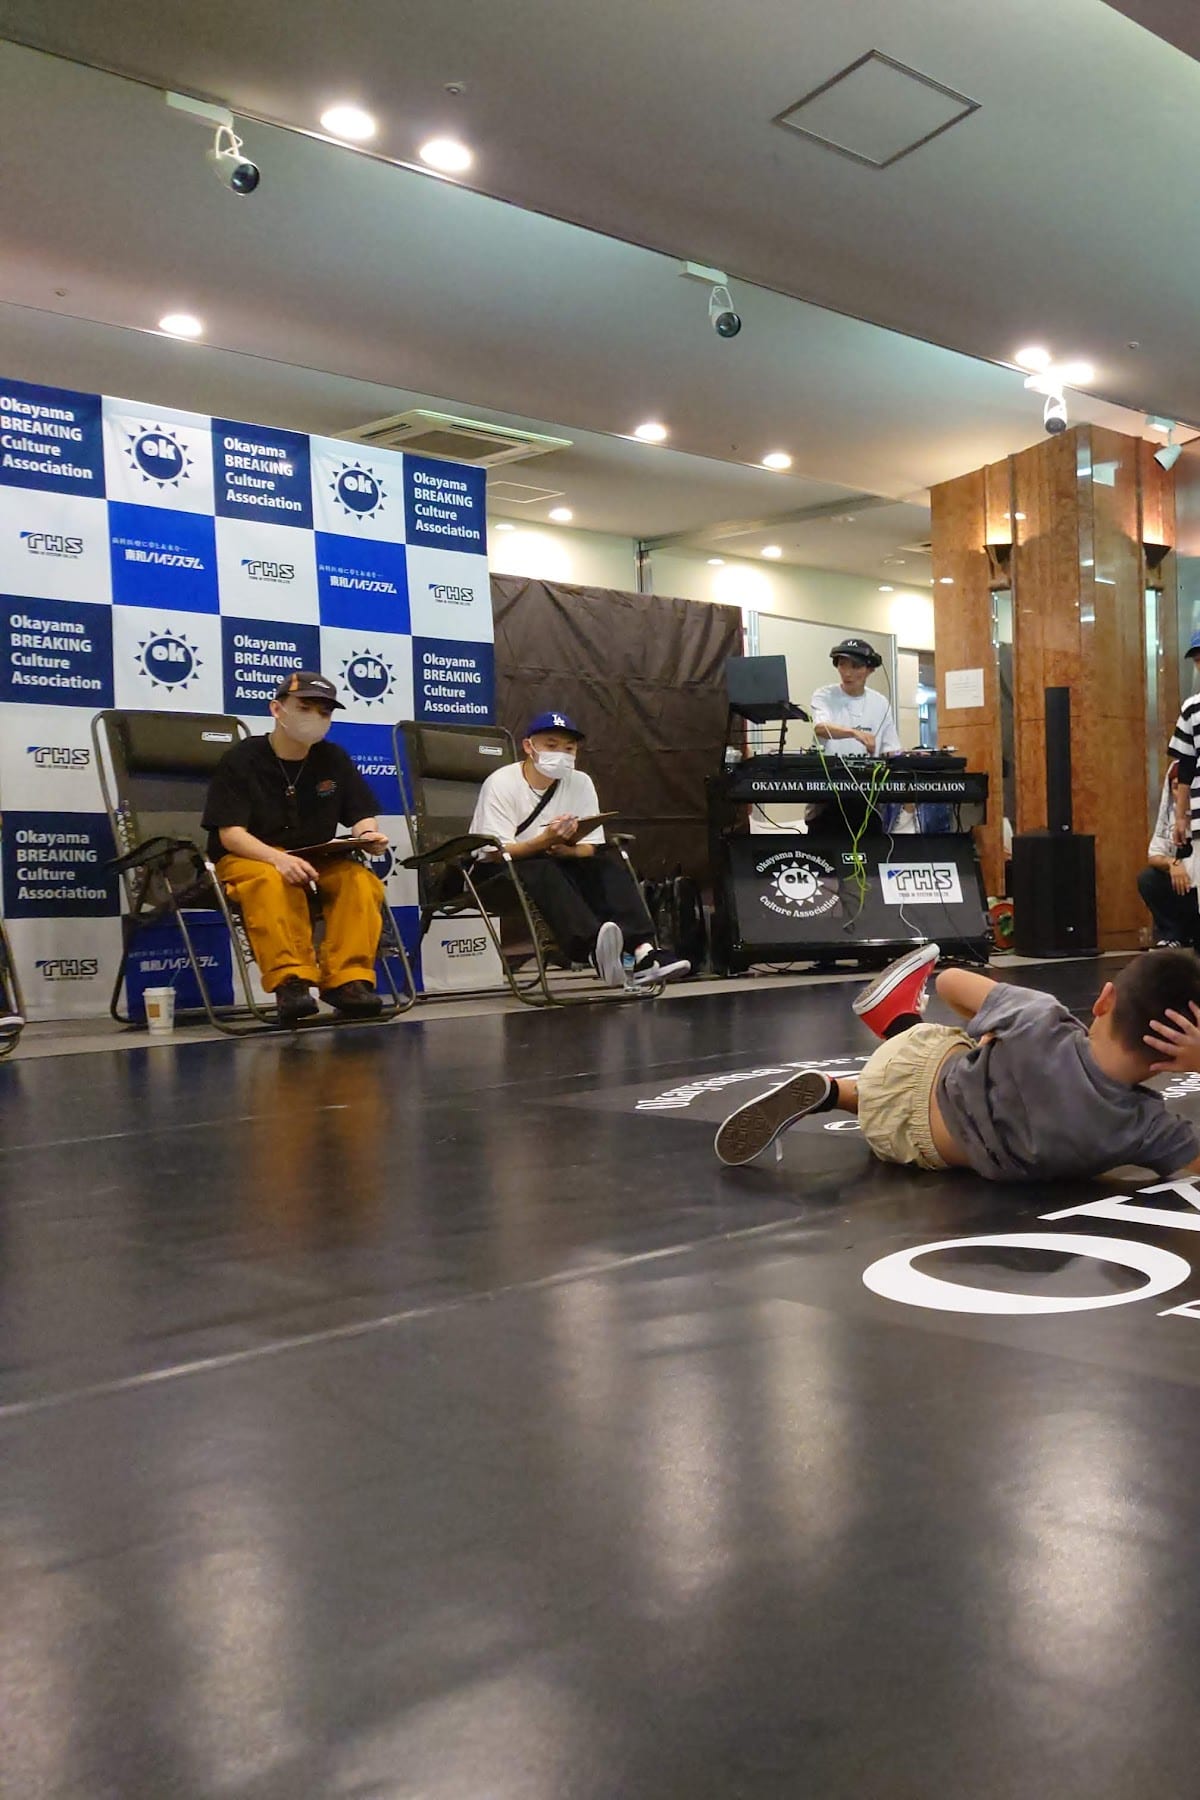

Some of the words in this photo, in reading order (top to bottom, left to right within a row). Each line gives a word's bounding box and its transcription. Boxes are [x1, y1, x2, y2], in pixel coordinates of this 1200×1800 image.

[0, 397, 75, 422] Okayama
[0, 415, 83, 442] BREAKING
[1, 435, 61, 456] Culture
[224, 437, 287, 459] Okayama
[3, 454, 93, 479] Association
[225, 454, 294, 477] BREAKING
[225, 471, 276, 491] Culture
[413, 471, 468, 492] Okayama
[226, 489, 302, 511] Association
[414, 487, 473, 508] BREAKING
[414, 503, 458, 520] Culture
[415, 519, 480, 540] Association
[19, 531, 83, 554] THS
[241, 559, 295, 580] THS
[428, 583, 474, 602] THS
[10, 614, 85, 634] Okayama
[11, 633, 92, 653] BREAKING
[233, 635, 297, 652] Okayama
[11, 652, 70, 669] Culture
[234, 652, 303, 669] BREAKING
[422, 653, 476, 669] Okayama
[12, 670, 101, 690] Association
[234, 669, 285, 685] Culture
[423, 669, 481, 684] BREAKING
[235, 686, 277, 700] Associ
[423, 684, 466, 698] Culture
[424, 700, 489, 714] Association
[27, 746, 90, 765] THS
[751, 781, 804, 791] OKAYAMA
[806, 781, 859, 791] BREAKING
[859, 782, 906, 792] CULTURE
[15, 830, 90, 846] Okayama
[16, 849, 97, 863] BREAKING
[756, 851, 794, 873] Okayama
[795, 850, 835, 873] Breaking
[17, 867, 76, 881] Culture
[887, 869, 953, 890] THS
[18, 886, 108, 900] Association
[760, 895, 792, 917] Culture
[793, 894, 840, 918] Association
[441, 936, 487, 954] THS
[35, 959, 98, 977] THS
[635, 1068, 793, 1110] Okayama
